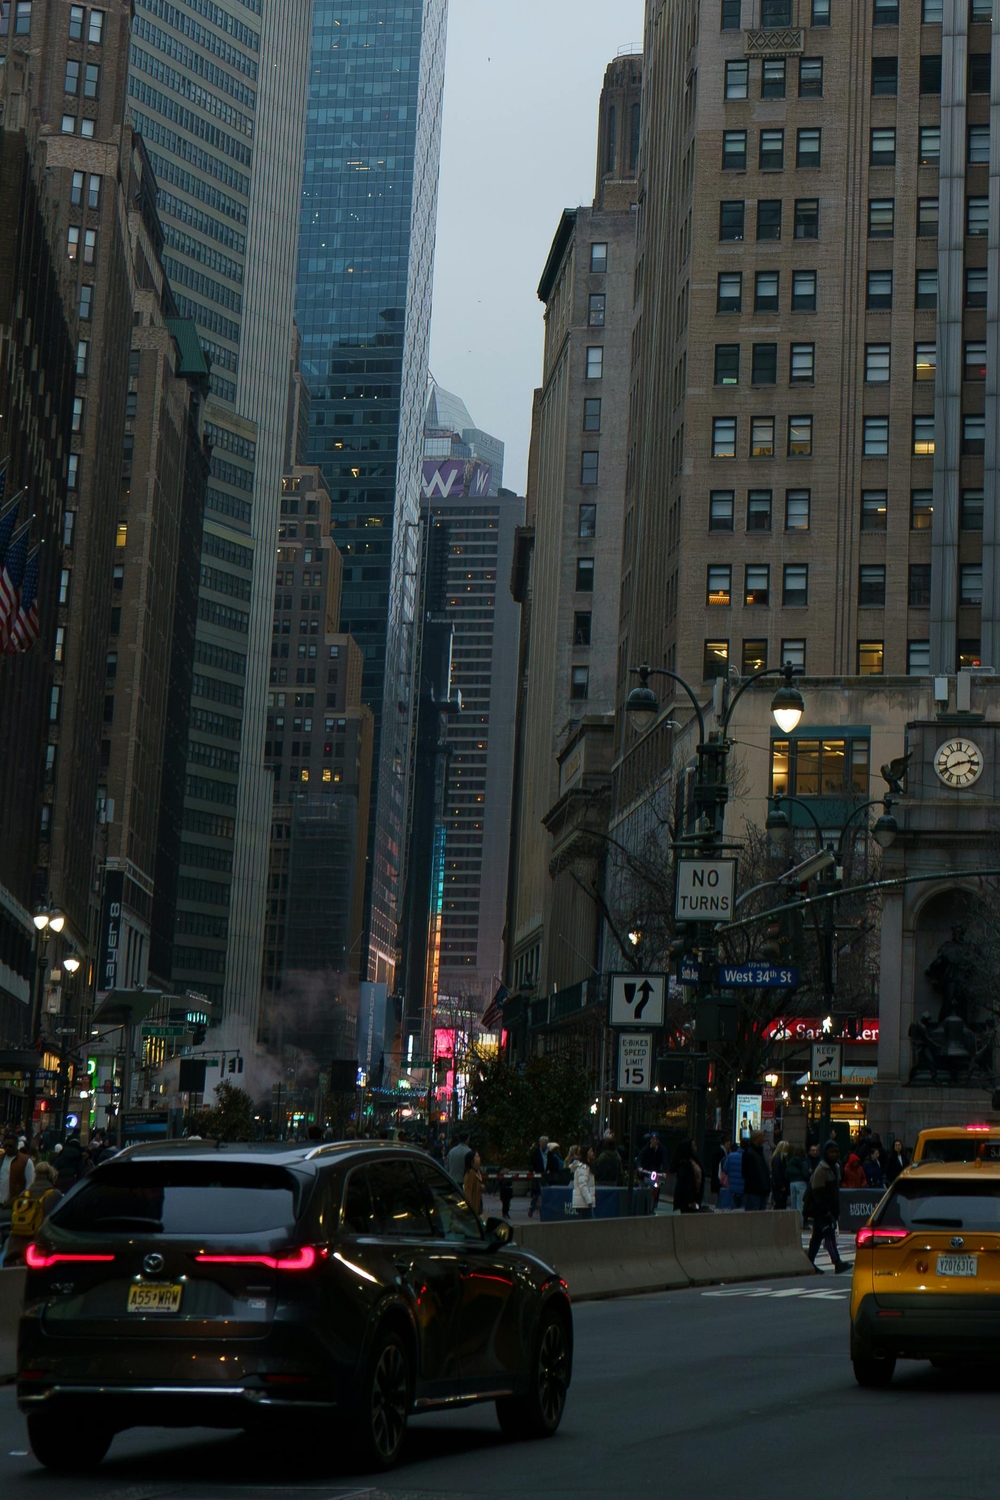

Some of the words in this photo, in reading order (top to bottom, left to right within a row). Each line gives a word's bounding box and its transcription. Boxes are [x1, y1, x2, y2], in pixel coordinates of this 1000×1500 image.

[692, 869, 719, 887] NO
[680, 895, 729, 911] TURNS
[724, 969, 753, 983] West
[755, 969, 778, 983] 34th
[780, 970, 792, 983] St
[795, 1023, 879, 1041] Saner
[624, 1068, 644, 1084] 15
[814, 1070, 837, 1078] RIGHT
